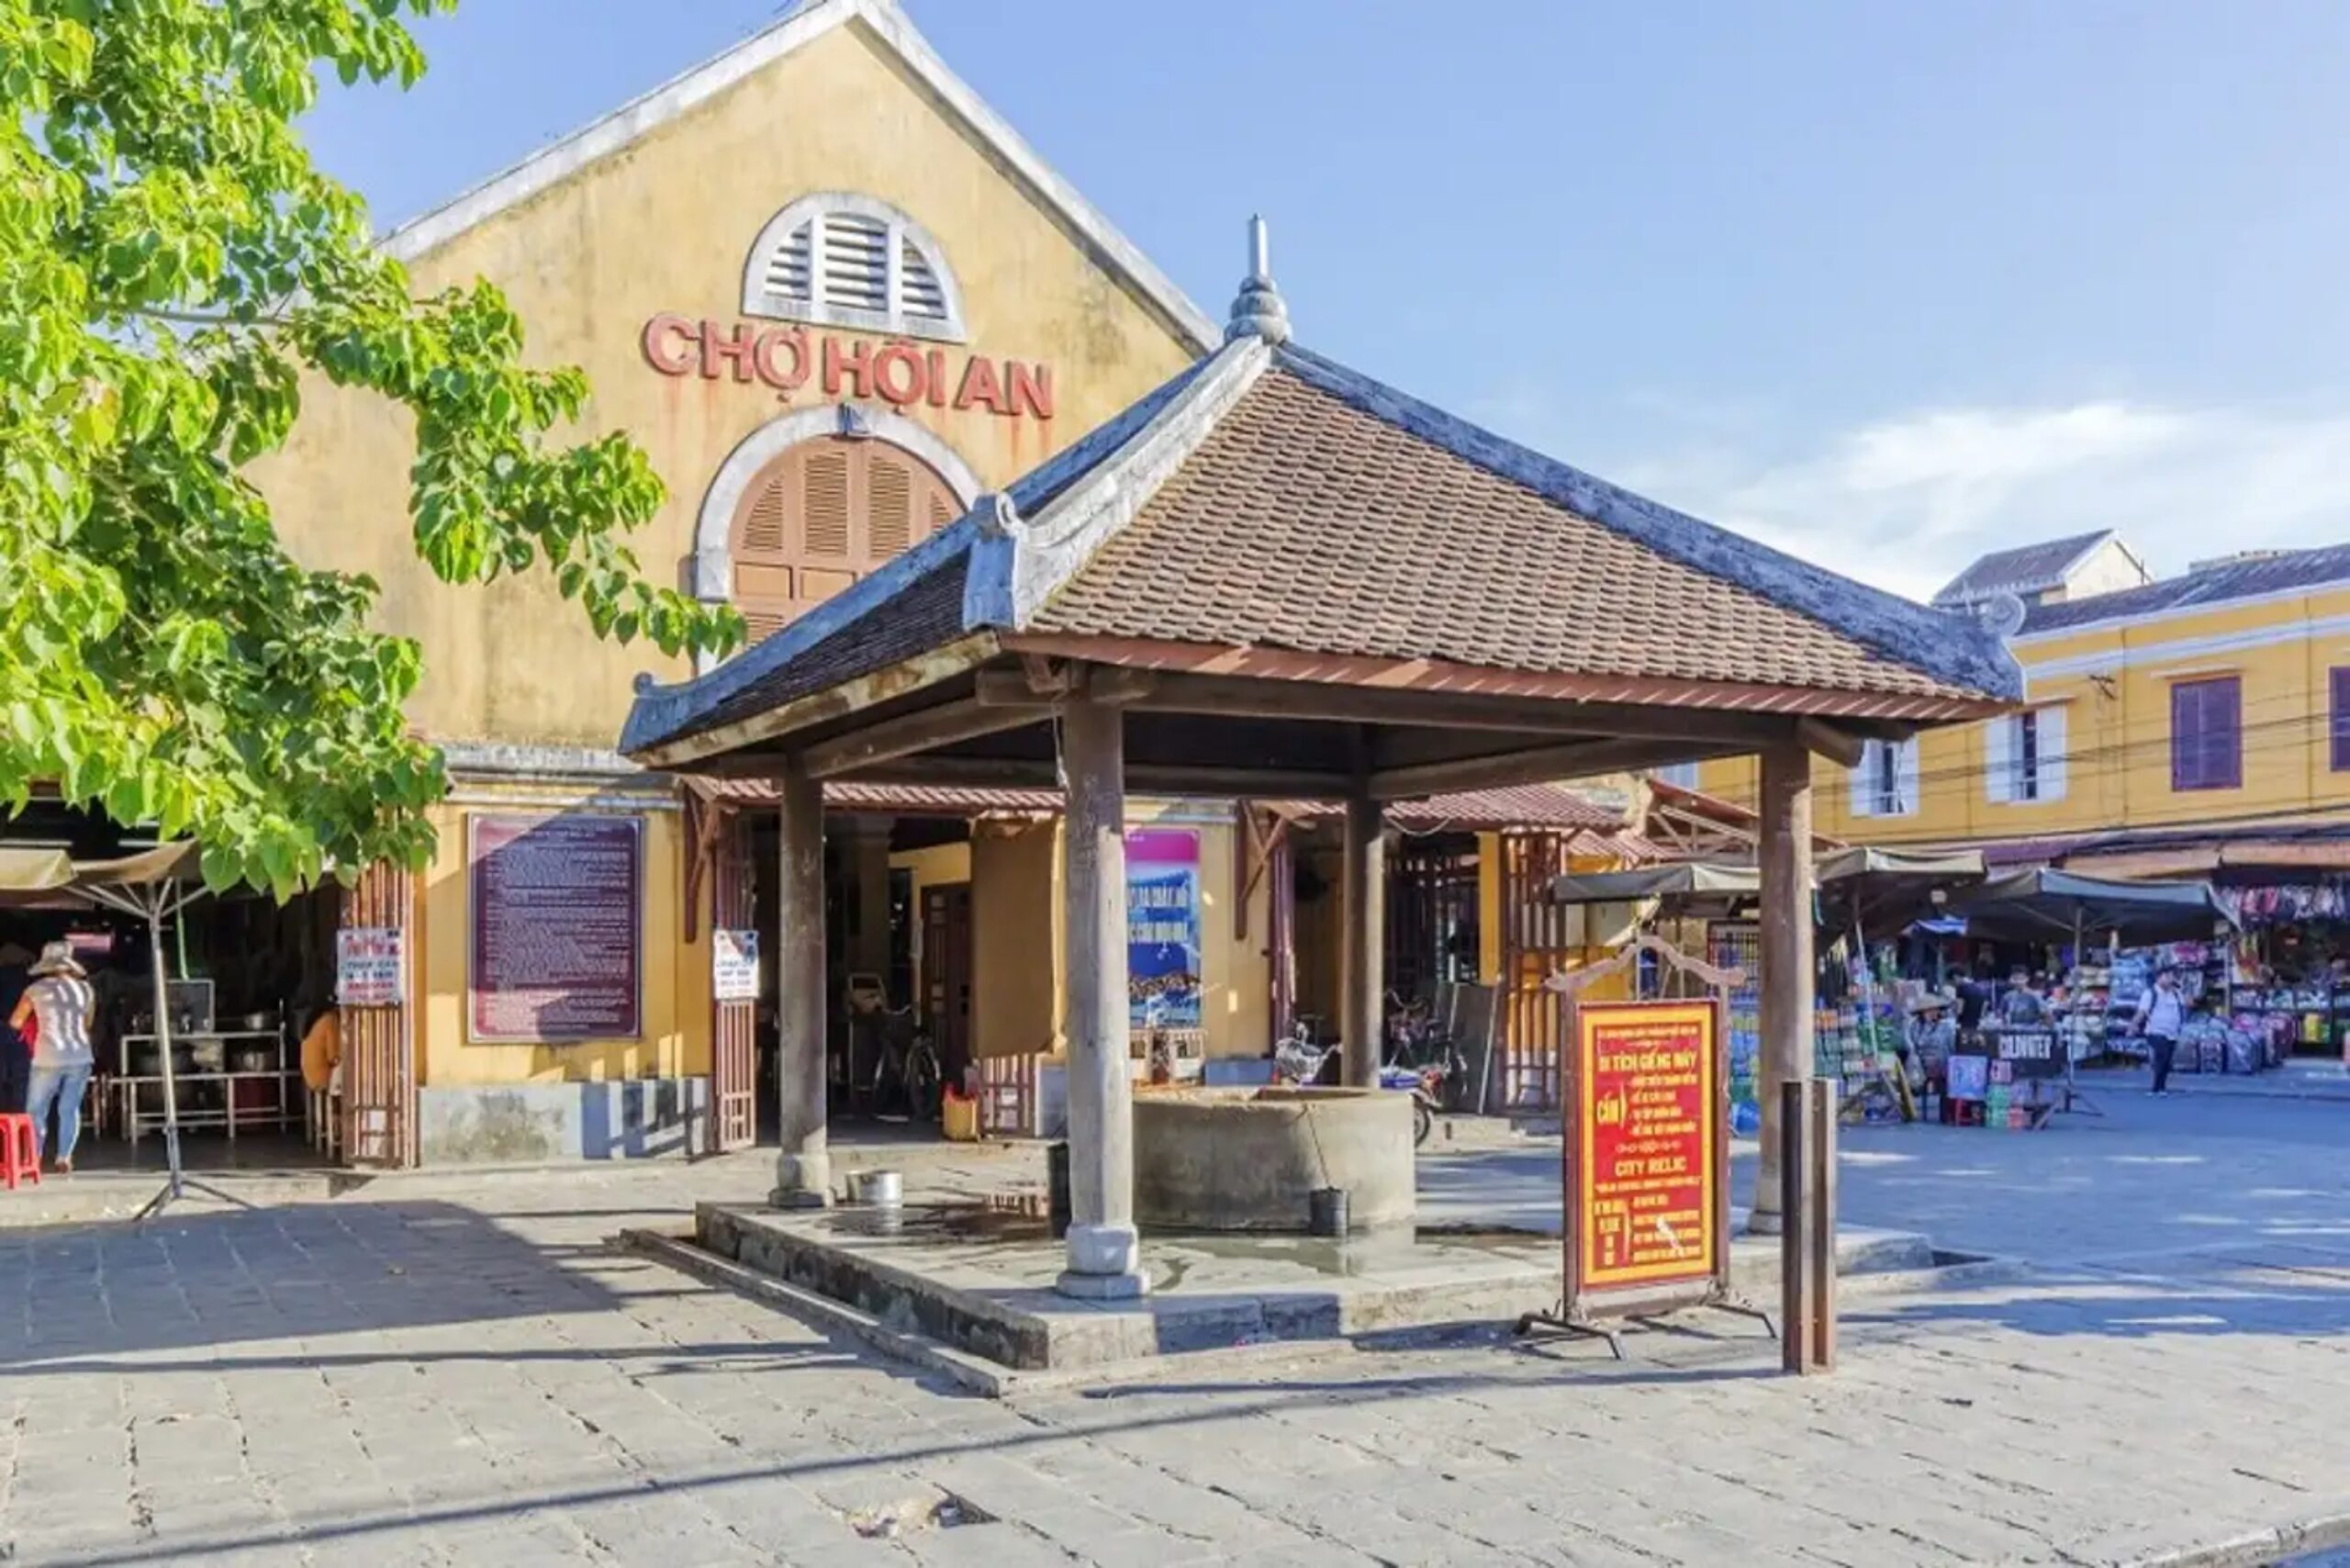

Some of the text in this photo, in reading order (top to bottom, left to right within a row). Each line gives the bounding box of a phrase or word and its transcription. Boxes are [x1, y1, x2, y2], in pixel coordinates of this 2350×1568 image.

[641, 312, 1053, 419] CHỢ HỘI AN
[1616, 1156, 1686, 1176] CITY RELIC
